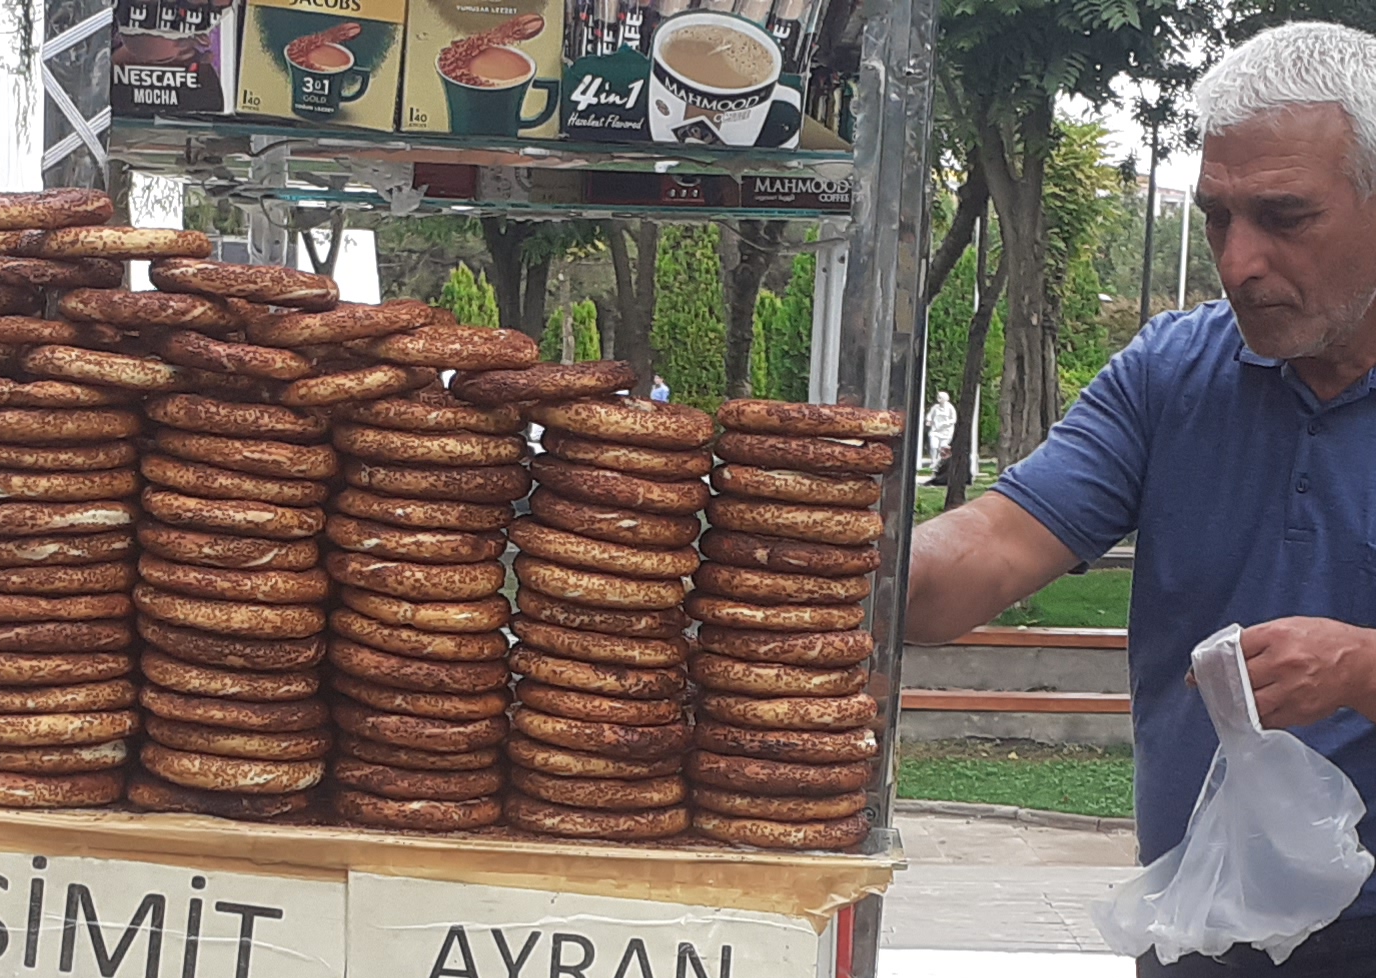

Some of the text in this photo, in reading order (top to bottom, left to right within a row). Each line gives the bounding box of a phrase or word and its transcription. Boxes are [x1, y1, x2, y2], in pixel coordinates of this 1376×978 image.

[134, 88, 178, 105] MOCHA
[665, 77, 759, 111] MAHMOOD
[755, 177, 849, 193] MAHMOOD
